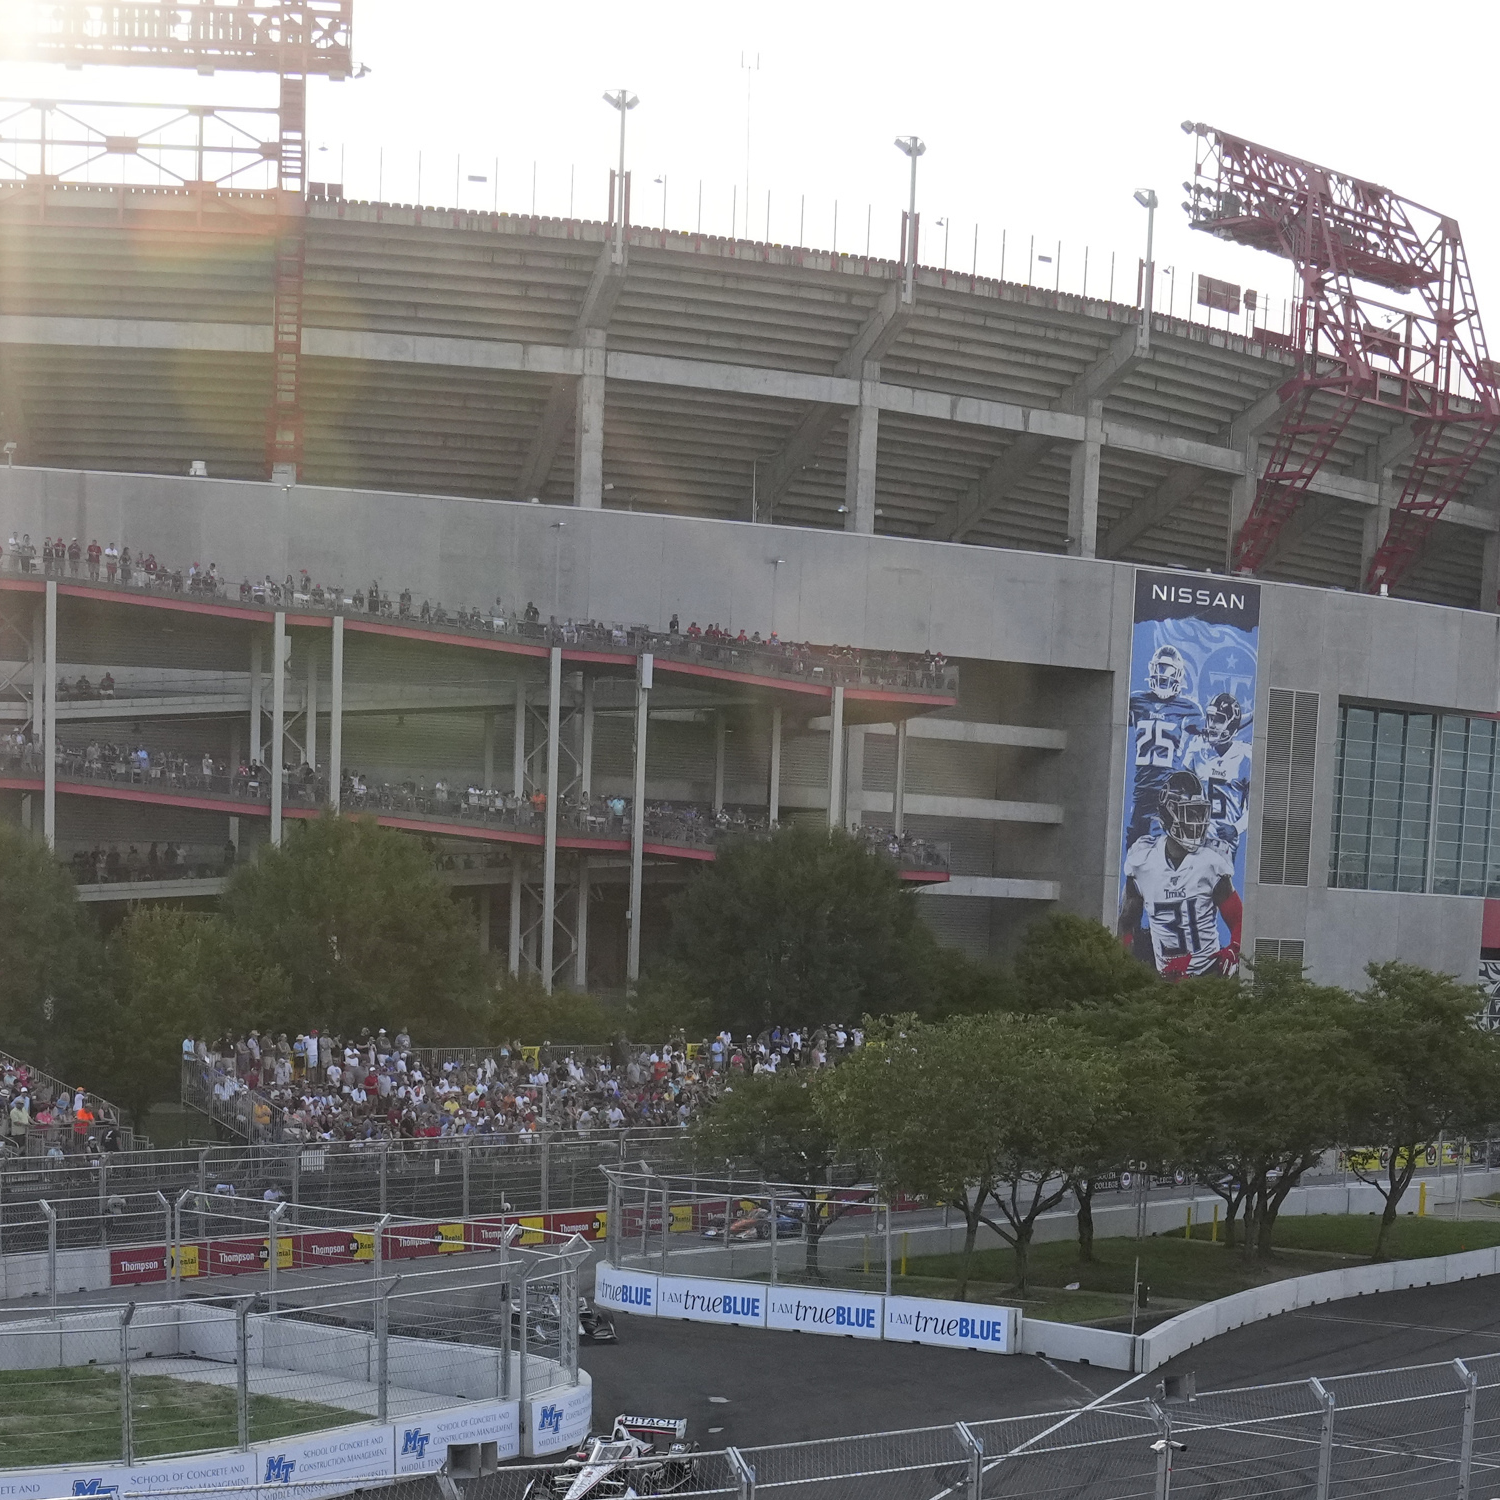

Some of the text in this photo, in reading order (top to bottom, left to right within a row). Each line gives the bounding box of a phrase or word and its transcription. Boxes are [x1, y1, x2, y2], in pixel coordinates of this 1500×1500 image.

[1151, 583, 1246, 611] NISSAN
[1134, 720, 1179, 766] 25
[1154, 901, 1201, 956] 31
[559, 1223, 589, 1234] Thompson
[311, 1243, 345, 1256] Thompson
[399, 1237, 431, 1248] Thompson
[120, 1260, 159, 1273] Thompson
[218, 1251, 255, 1263] Thompson
[600, 1280, 652, 1307] trueBLUE
[661, 1286, 761, 1318] I AM trueBLUE
[771, 1298, 876, 1329] I AM trueBLUE
[889, 1308, 1002, 1342] I AM trueBLUE
[436, 1411, 510, 1433] SCHOOL OF CONCRETE AND
[538, 1403, 564, 1435] MT
[624, 1415, 679, 1429] HITACHI
[401, 1427, 430, 1459] MT
[432, 1422, 513, 1446] CONSTRUCTION MANAGEMENT
[303, 1435, 384, 1459] SCHOOL OF CONCRETE AND
[264, 1453, 297, 1484] MT
[299, 1447, 388, 1473] CONSTRUCTION MANAGEMENT
[400, 1461, 425, 1473] MIDDLE
[130, 1464, 246, 1486] SCHOOL OF CONCRETE AND
[18, 1483, 41, 1494] AND
